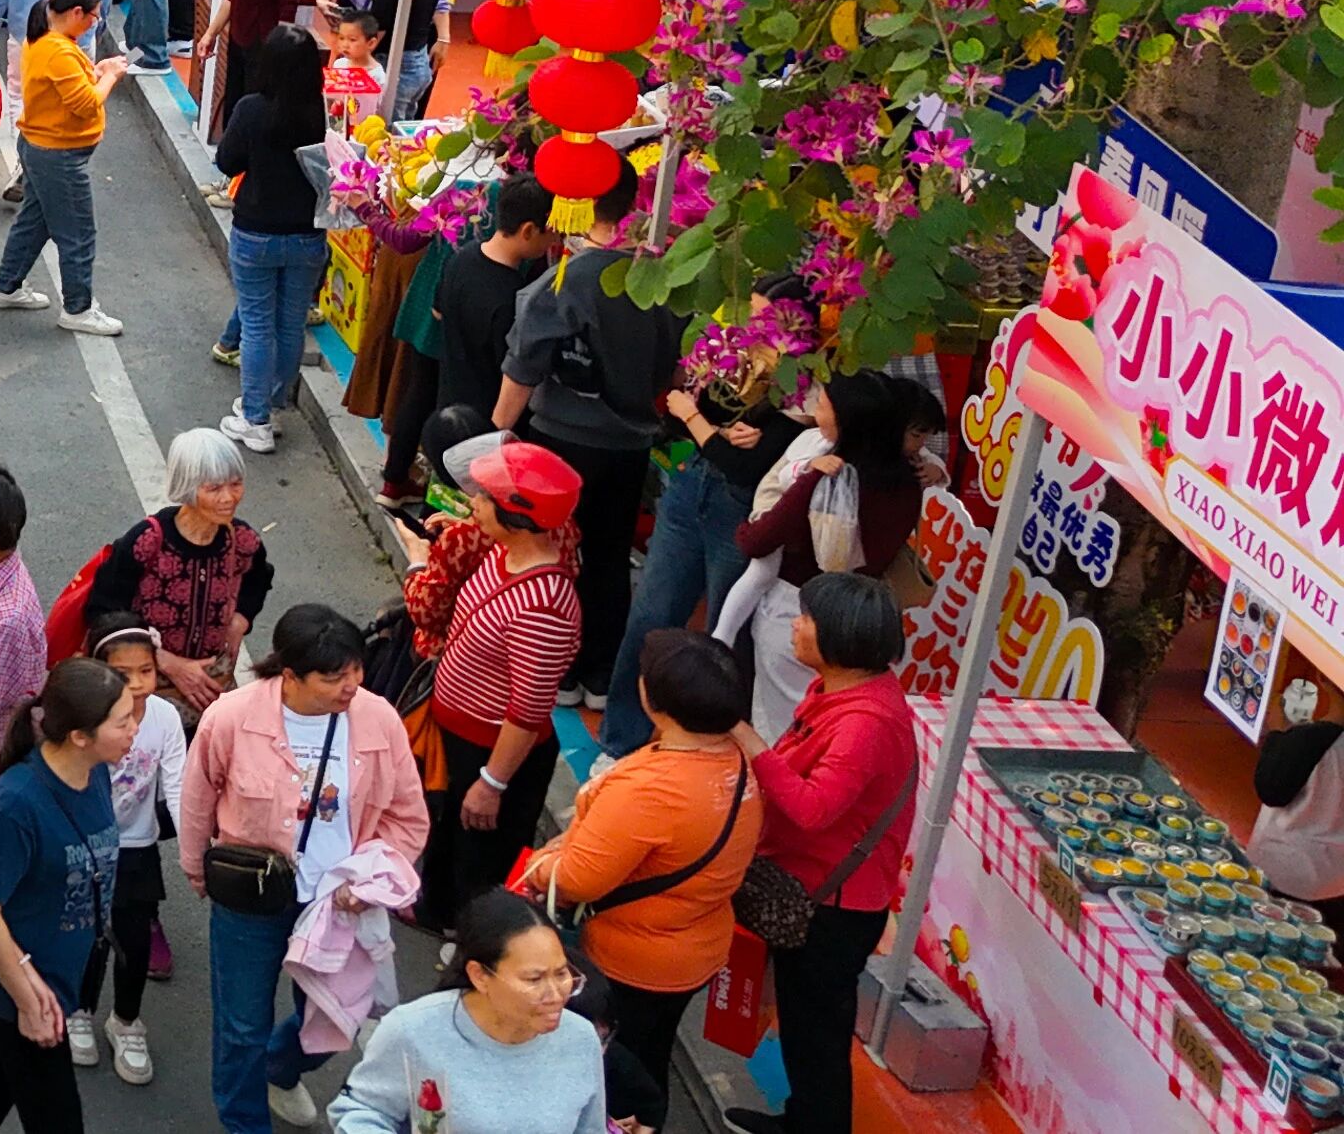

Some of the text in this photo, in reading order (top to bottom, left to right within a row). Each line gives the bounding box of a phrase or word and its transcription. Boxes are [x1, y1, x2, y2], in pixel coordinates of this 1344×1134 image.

[1175, 474, 1340, 627] XIAO XIAO WEI
